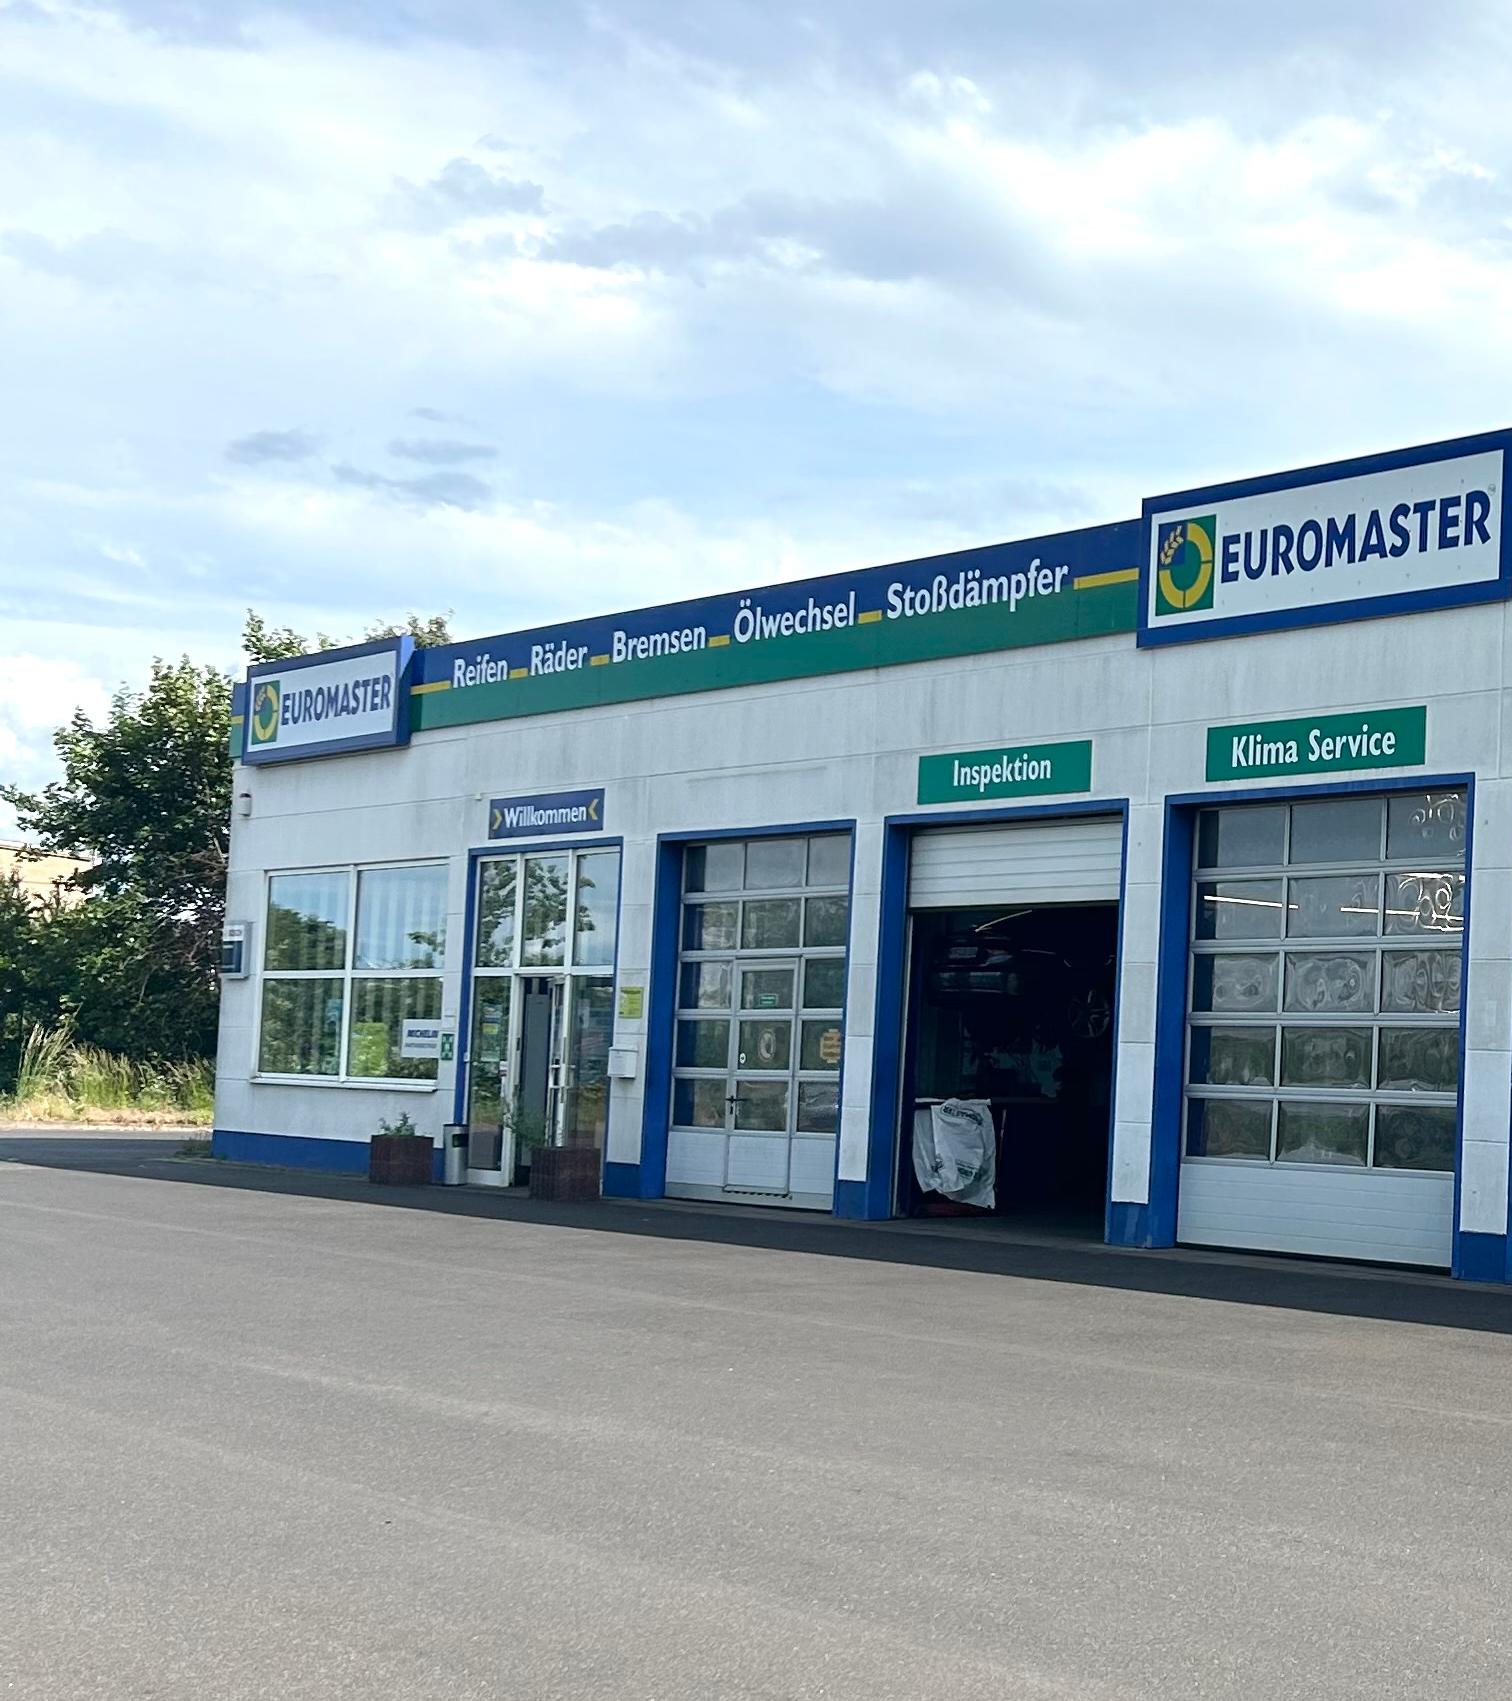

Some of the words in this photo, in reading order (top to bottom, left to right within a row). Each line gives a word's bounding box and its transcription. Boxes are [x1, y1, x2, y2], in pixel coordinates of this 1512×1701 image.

[1220, 489, 1492, 584] EUROMASTER
[452, 653, 509, 689] Reifen
[529, 640, 588, 677] Räder
[612, 626, 706, 663] Bremsen
[733, 591, 856, 643] Ölwechsel
[886, 558, 1069, 620] Stoßdämpfer
[280, 674, 392, 726] EUROMASTER
[1231, 733, 1299, 768] Klima
[1308, 724, 1396, 762] Service
[953, 753, 1051, 793] Inspektion
[503, 805, 587, 829] Willkommen
